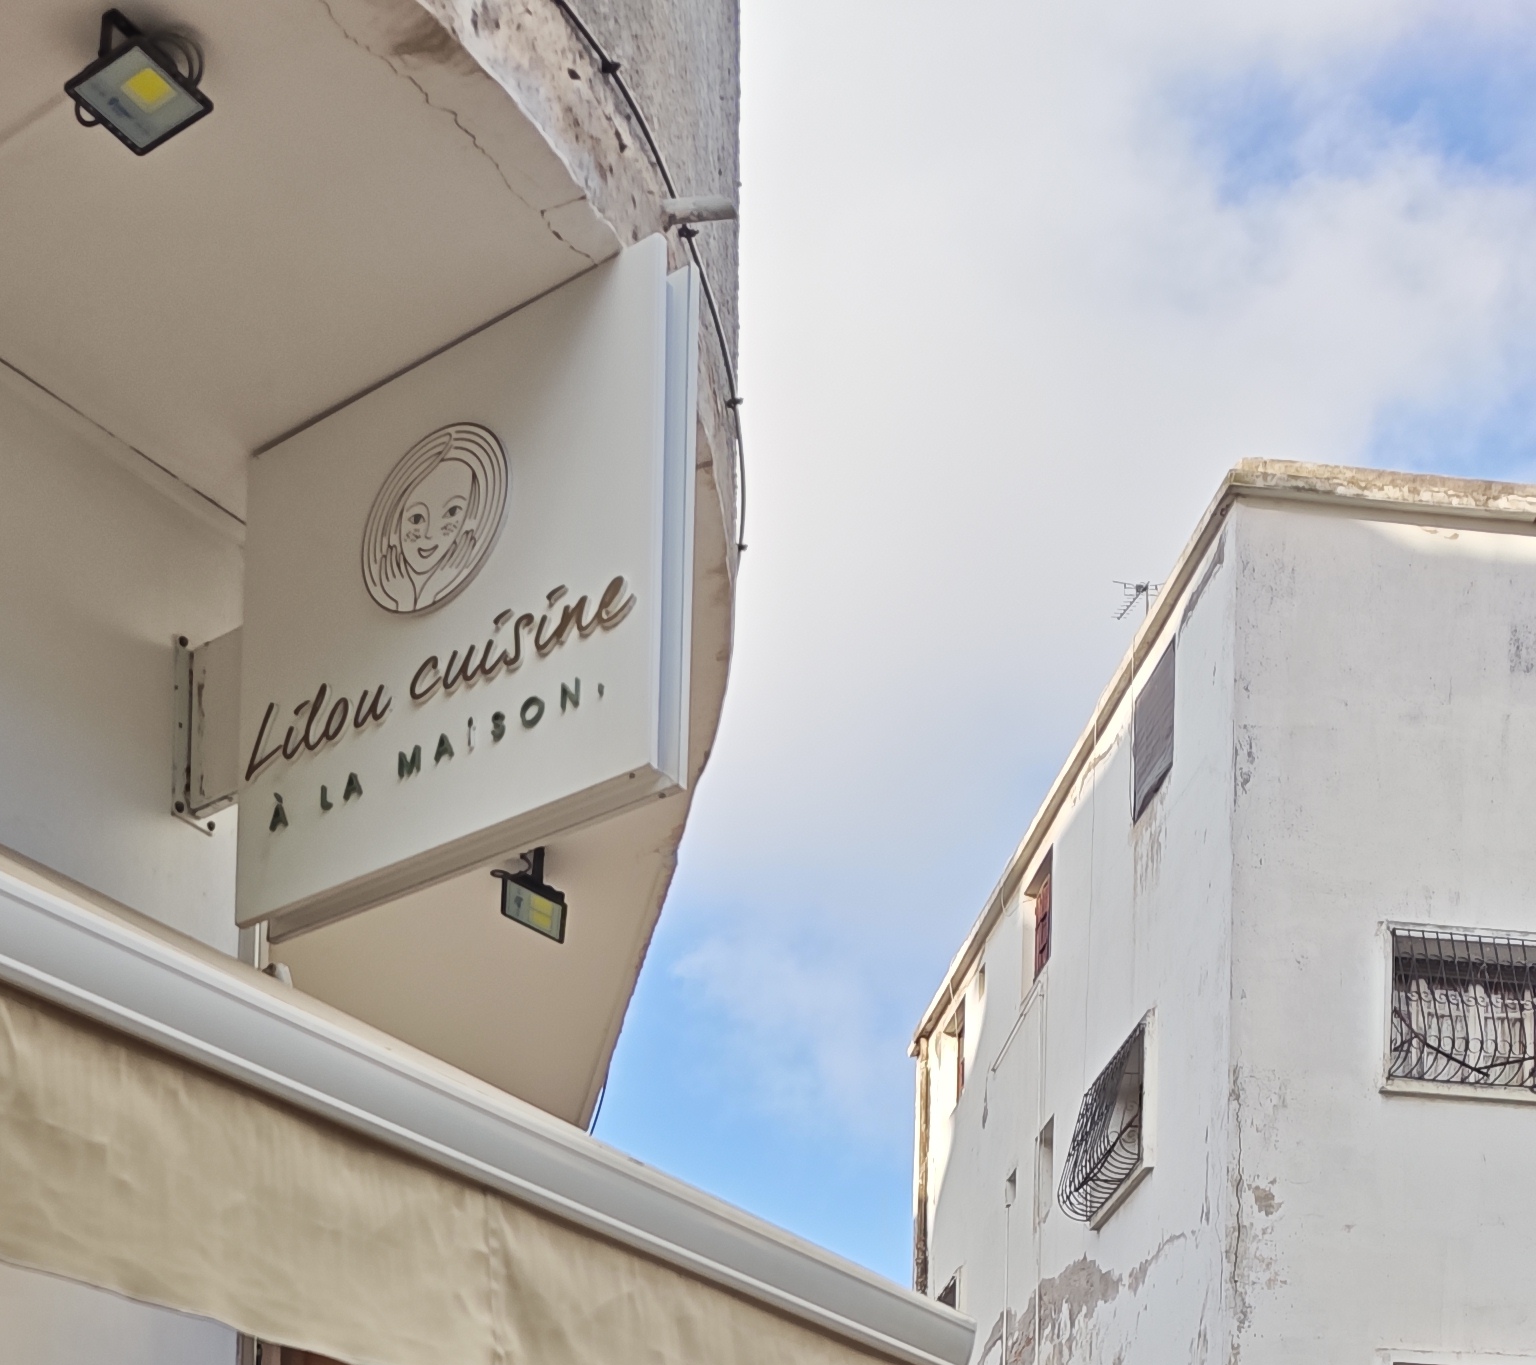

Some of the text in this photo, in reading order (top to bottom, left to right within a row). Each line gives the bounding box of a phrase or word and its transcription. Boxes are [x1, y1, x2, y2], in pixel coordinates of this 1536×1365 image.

[245, 575, 636, 782] Lilou cuisine
[268, 792, 289, 833] À
[319, 771, 364, 811] LA
